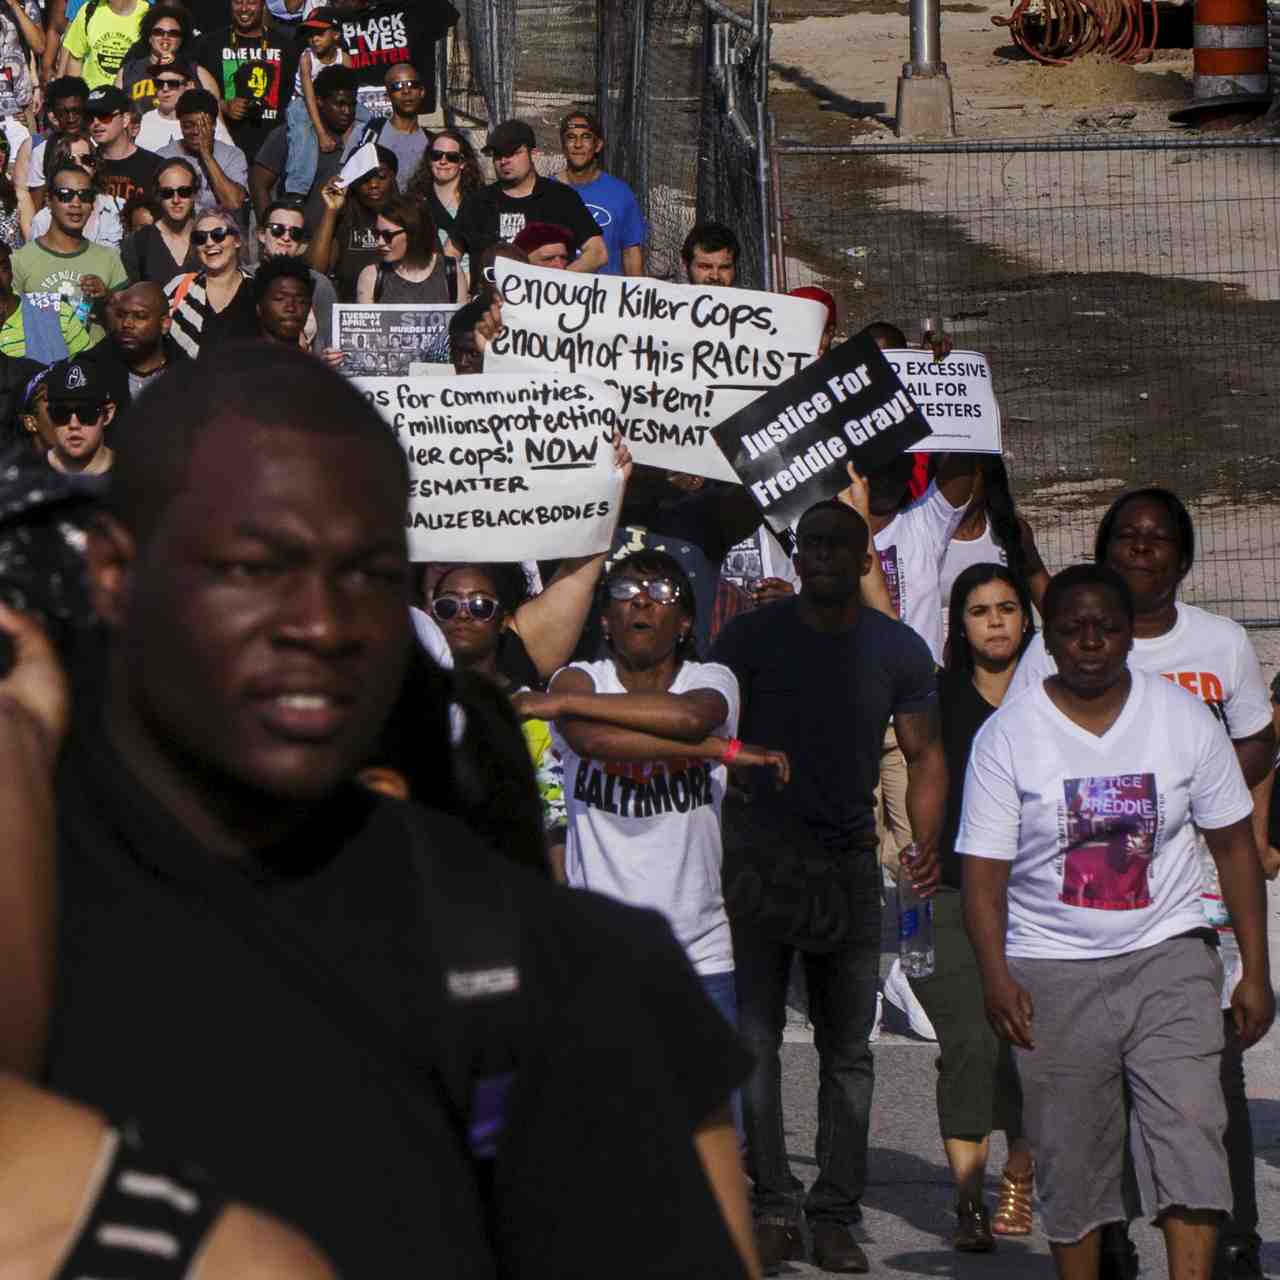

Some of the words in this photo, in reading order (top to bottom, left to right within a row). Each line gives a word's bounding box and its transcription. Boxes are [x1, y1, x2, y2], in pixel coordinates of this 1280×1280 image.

[342, 12, 406, 38] BLACK
[222, 47, 245, 61] ONE
[346, 29, 408, 57] LIVES
[351, 50, 410, 69] MATTER
[341, 312, 381, 320] TUESDAY
[502, 273, 607, 333] enough
[618, 282, 688, 320] Killer
[691, 294, 778, 338] Cops,
[341, 319, 367, 327] APRIL
[490, 325, 596, 374] enough
[597, 335, 628, 371] of
[632, 334, 683, 379] this
[692, 339, 813, 382] RACIST
[906, 361, 988, 378] EXCESSIVE
[396, 384, 434, 409] for
[441, 379, 594, 408] communities.
[935, 383, 968, 397] FOR
[408, 414, 489, 437] millions
[490, 404, 618, 445] protecting
[740, 389, 833, 461] Justice
[826, 362, 873, 403] For
[448, 444, 514, 475] cops!
[525, 438, 599, 465] NOW
[750, 433, 849, 508] Freddie
[843, 389, 915, 447] Gray!
[573, 761, 715, 818] BALTIMORE
[1080, 798, 1155, 818] FREDDIE
